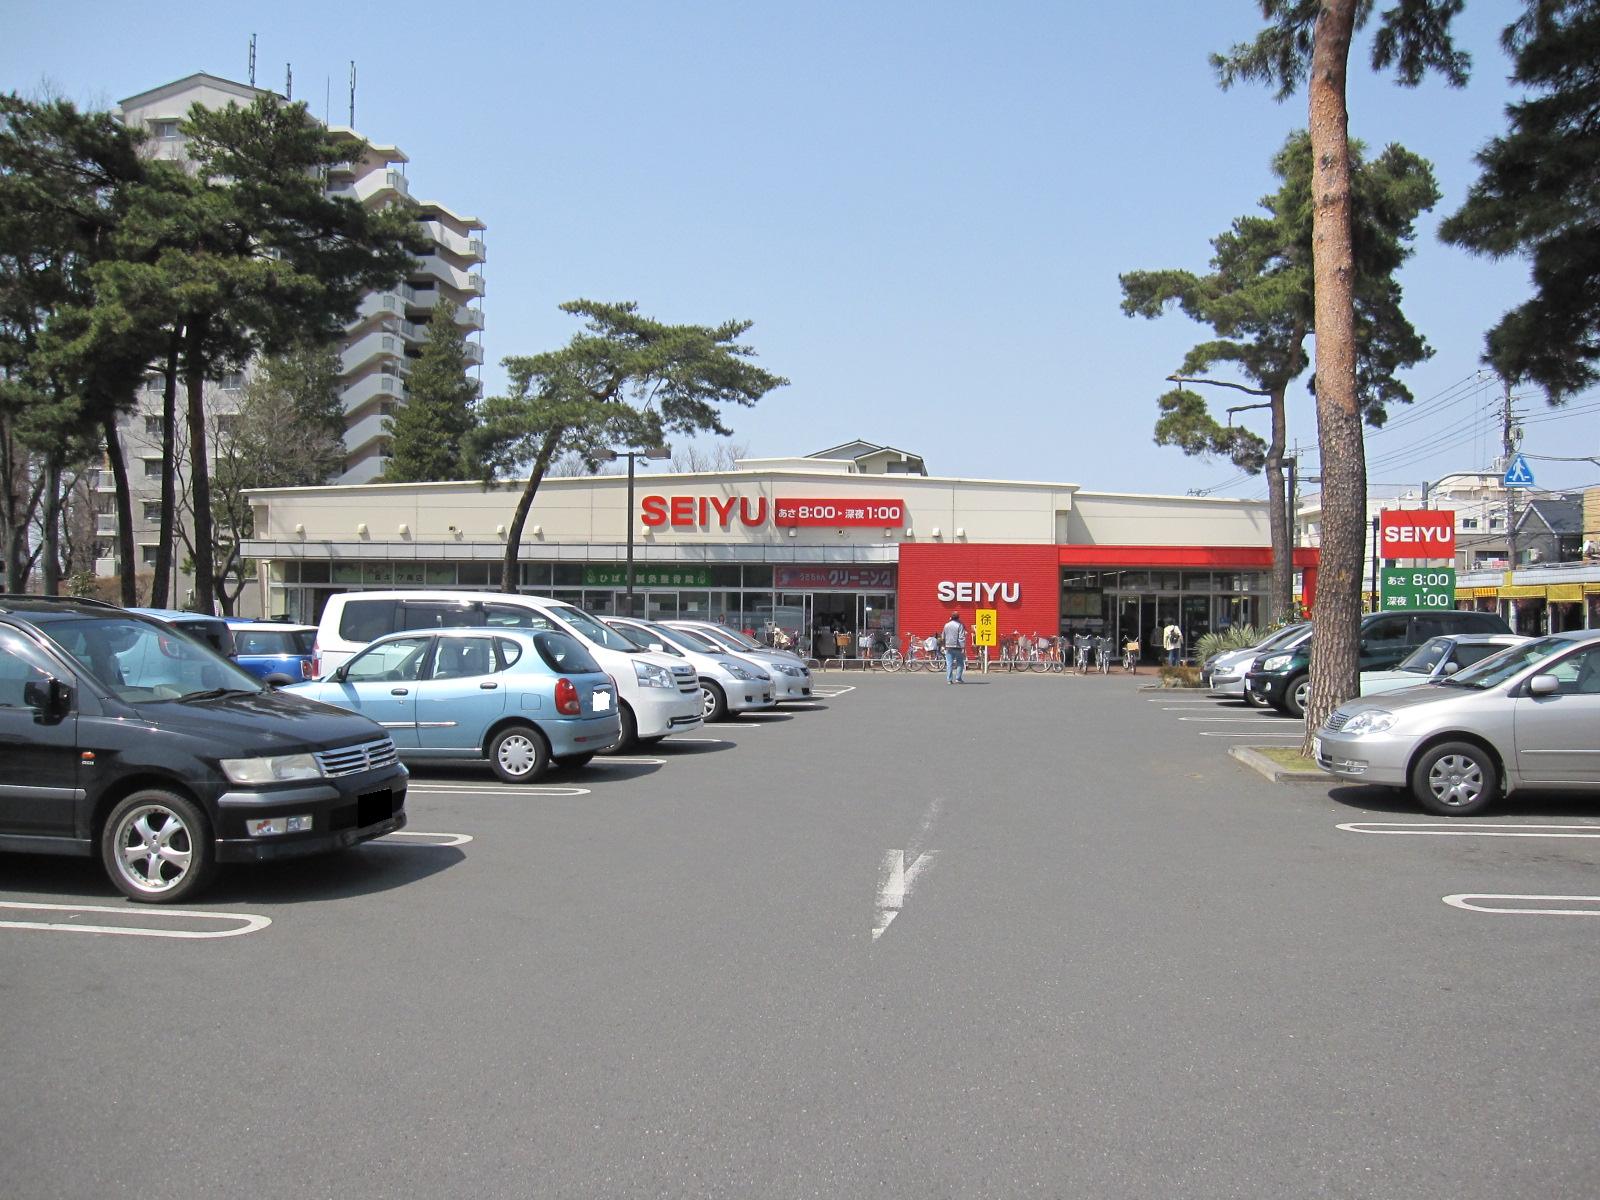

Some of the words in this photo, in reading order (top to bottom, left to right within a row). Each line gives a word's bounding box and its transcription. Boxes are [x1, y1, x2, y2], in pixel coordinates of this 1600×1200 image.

[641, 495, 767, 527] SEIYU
[778, 508, 796, 519] あさ
[798, 506, 836, 519] 8:00
[844, 508, 865, 519] 深夜
[866, 506, 900, 519] 1:00
[1384, 526, 1450, 542] SEIYU
[829, 570, 890, 585] クリーニング
[1387, 576, 1407, 585] あさ
[1412, 574, 1448, 586] 8:00
[937, 581, 1020, 603] SEIYU
[1386, 596, 1407, 606] 深夜
[1414, 594, 1448, 606] 1:00
[980, 614, 992, 642] 徐行
